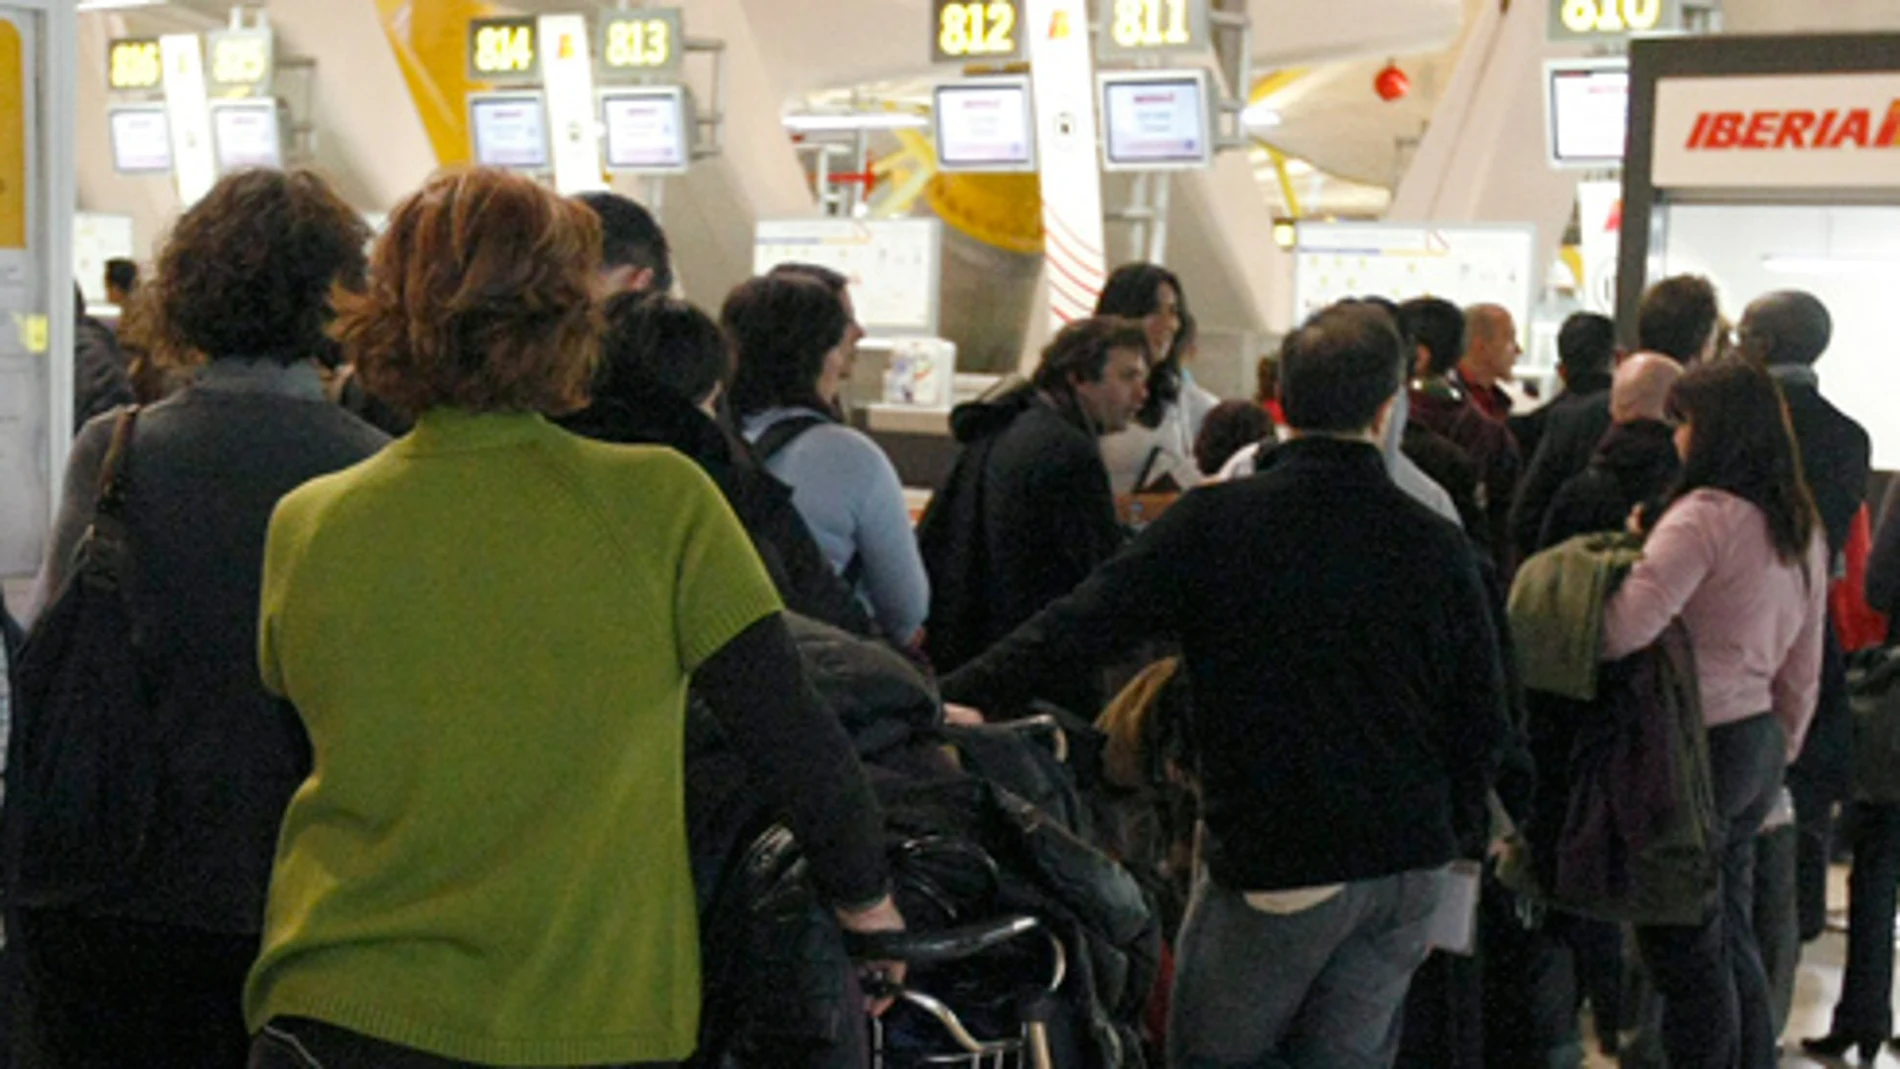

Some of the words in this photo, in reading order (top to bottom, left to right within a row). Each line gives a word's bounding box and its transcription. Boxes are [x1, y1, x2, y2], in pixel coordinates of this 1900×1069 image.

[606, 20, 668, 66] 813
[939, 2, 1015, 55] 812
[1112, 0, 1190, 46] 811
[474, 25, 532, 71] 814
[1685, 108, 1871, 149] IBERIA
